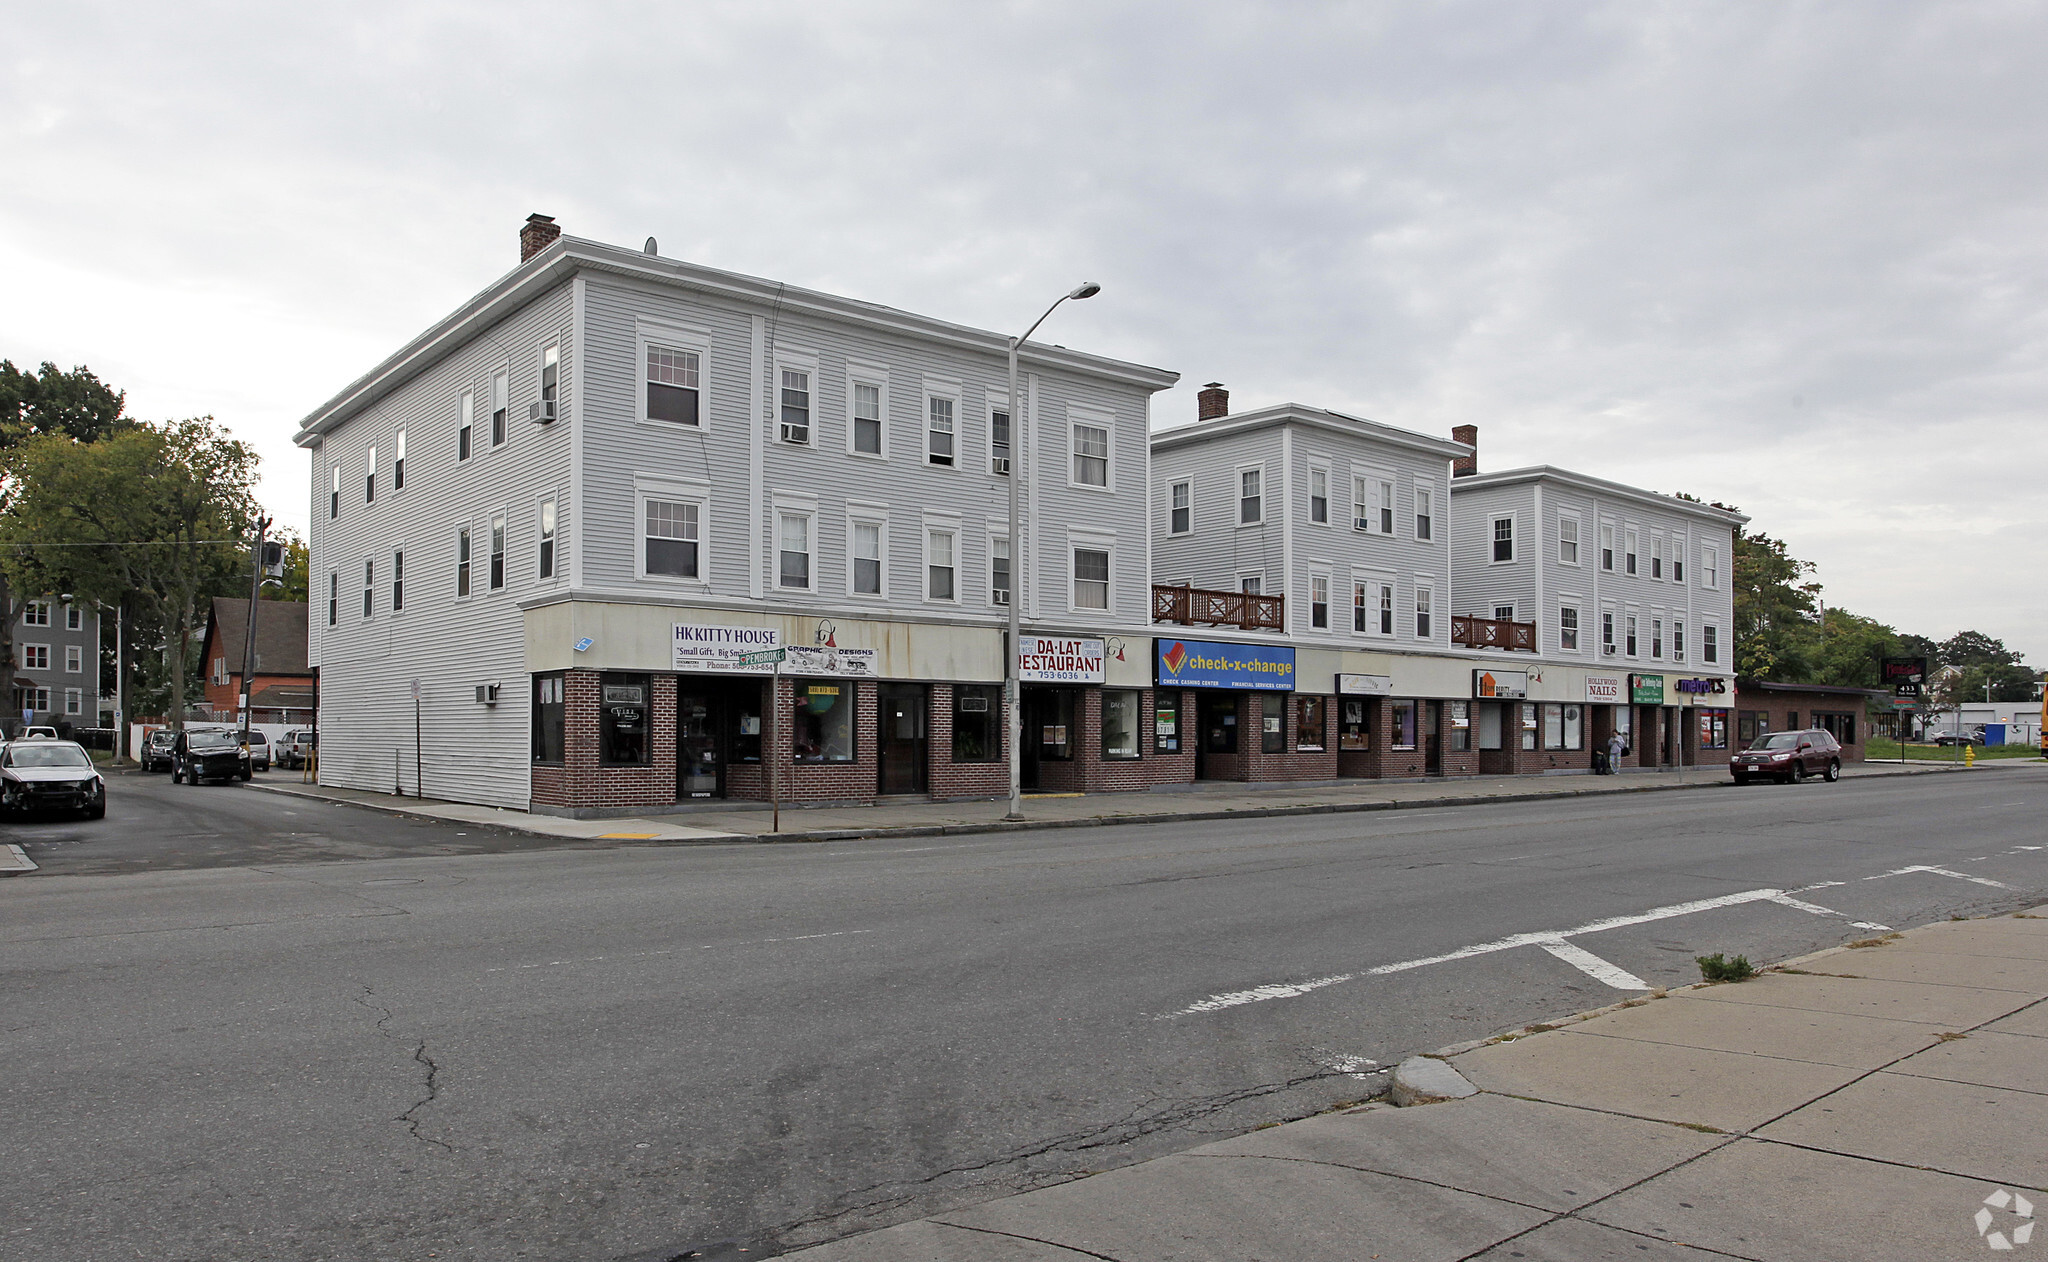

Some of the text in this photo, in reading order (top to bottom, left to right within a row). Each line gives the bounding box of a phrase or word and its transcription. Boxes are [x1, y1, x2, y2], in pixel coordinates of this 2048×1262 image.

[676, 626, 776, 644] HK KITTY HOUSE
[718, 649, 729, 658] Big
[746, 650, 781, 665] PEMBROKE
[707, 661, 730, 669] Phone:
[1190, 655, 1292, 676] check-x-change
[1588, 677, 1618, 685] HOLLYWOOD
[1589, 686, 1617, 696] NAILS
